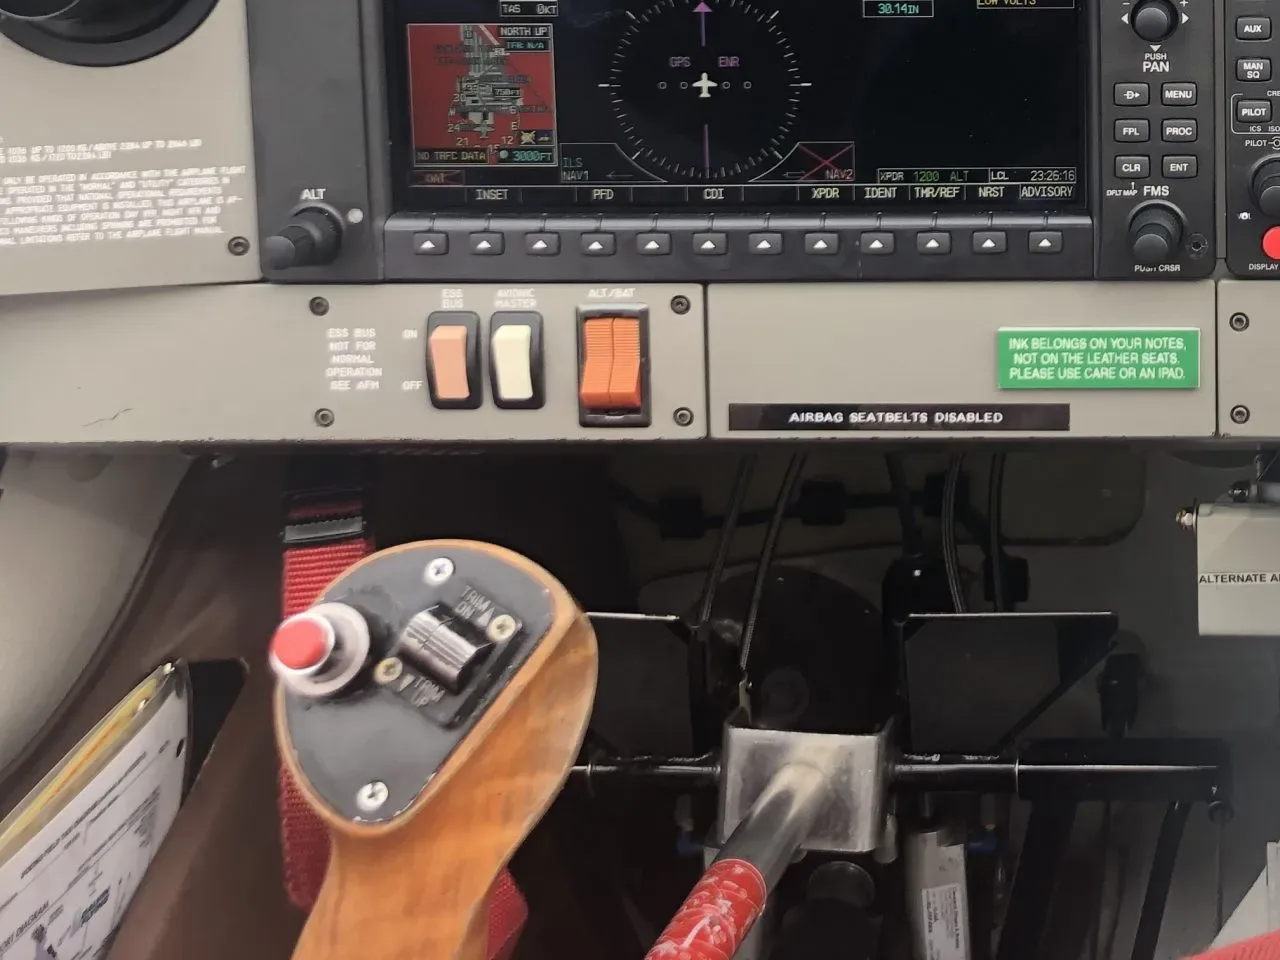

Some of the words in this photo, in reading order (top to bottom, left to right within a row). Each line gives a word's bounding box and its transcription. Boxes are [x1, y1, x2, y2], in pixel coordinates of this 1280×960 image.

[878, 3, 919, 14] 30.14IN
[1244, 25, 1262, 33] AUX
[1143, 62, 1169, 72] PAN
[1166, 90, 1192, 98] MENU
[1242, 108, 1266, 116] PILOT
[1123, 128, 1139, 136] FPL
[1166, 127, 1192, 136] PROC
[1122, 164, 1140, 172] CLR
[1170, 164, 1188, 172] ENT
[1031, 171, 1075, 181] 23:26:16
[476, 190, 509, 200] INSET
[593, 189, 614, 200] PFD
[704, 188, 724, 200] CDI
[812, 188, 839, 199] XPDR
[864, 188, 897, 198] IDENT
[914, 187, 959, 198] TMR/REF
[979, 187, 1004, 197] NRST
[1021, 186, 1073, 198] ADVISORY
[1144, 186, 1169, 196] FMS
[1249, 263, 1278, 271] DISPLAY
[1009, 338, 1028, 349] INK
[1031, 338, 1087, 349] BELONGS
[1090, 338, 1107, 349] ON
[1111, 338, 1142, 349] YOUR
[1145, 338, 1186, 351] NOTES,
[1014, 353, 1037, 363] NOT
[1041, 353, 1058, 363] ON
[1063, 353, 1084, 363] THE
[1088, 353, 1138, 363] LEATHER
[1142, 353, 1179, 364] SEATS.
[1010, 368, 1055, 379] PLEASE
[1058, 368, 1081, 378] USE
[1085, 368, 1115, 378] CARE
[1119, 368, 1136, 378] OR
[1139, 368, 1155, 378] AN
[789, 413, 843, 423] AIRBAG
[849, 412, 927, 423] SEATBELTS
[934, 412, 1003, 423] DISABLED
[1199, 573, 1264, 584] ALTERNATE
